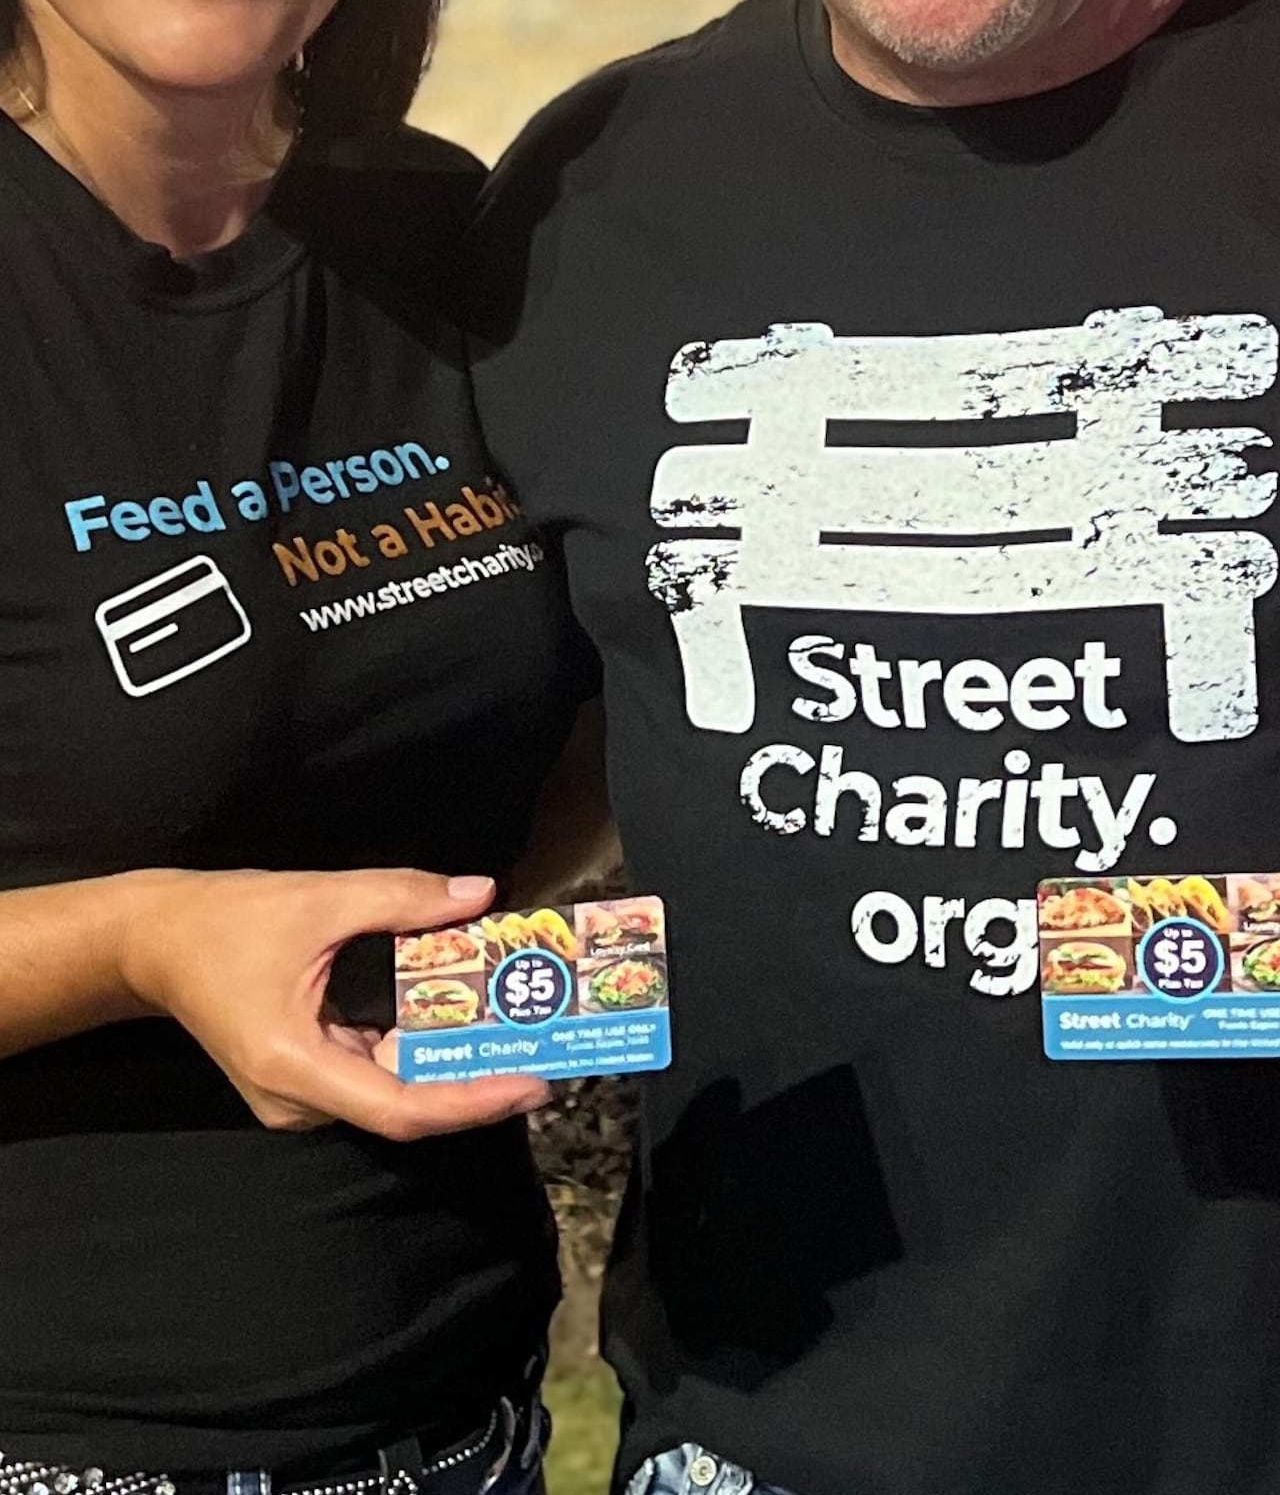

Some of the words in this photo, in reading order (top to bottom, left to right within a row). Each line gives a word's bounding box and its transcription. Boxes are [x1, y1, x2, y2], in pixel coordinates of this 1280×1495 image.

[64, 481, 227, 552] Feed
[231, 481, 268, 521] a
[269, 442, 450, 513] Person.
[272, 528, 370, 587] Not
[371, 524, 409, 558] a
[788, 635, 1127, 731] Street
[739, 744, 1177, 872] Charity.
[851, 891, 1039, 996] org
[1153, 939, 1207, 978] $5
[505, 967, 555, 1008] $5
[414, 1043, 472, 1064] Street
[479, 1039, 539, 1057] Charity
[1059, 1011, 1121, 1030] Street
[1125, 1012, 1190, 1032] Charity
